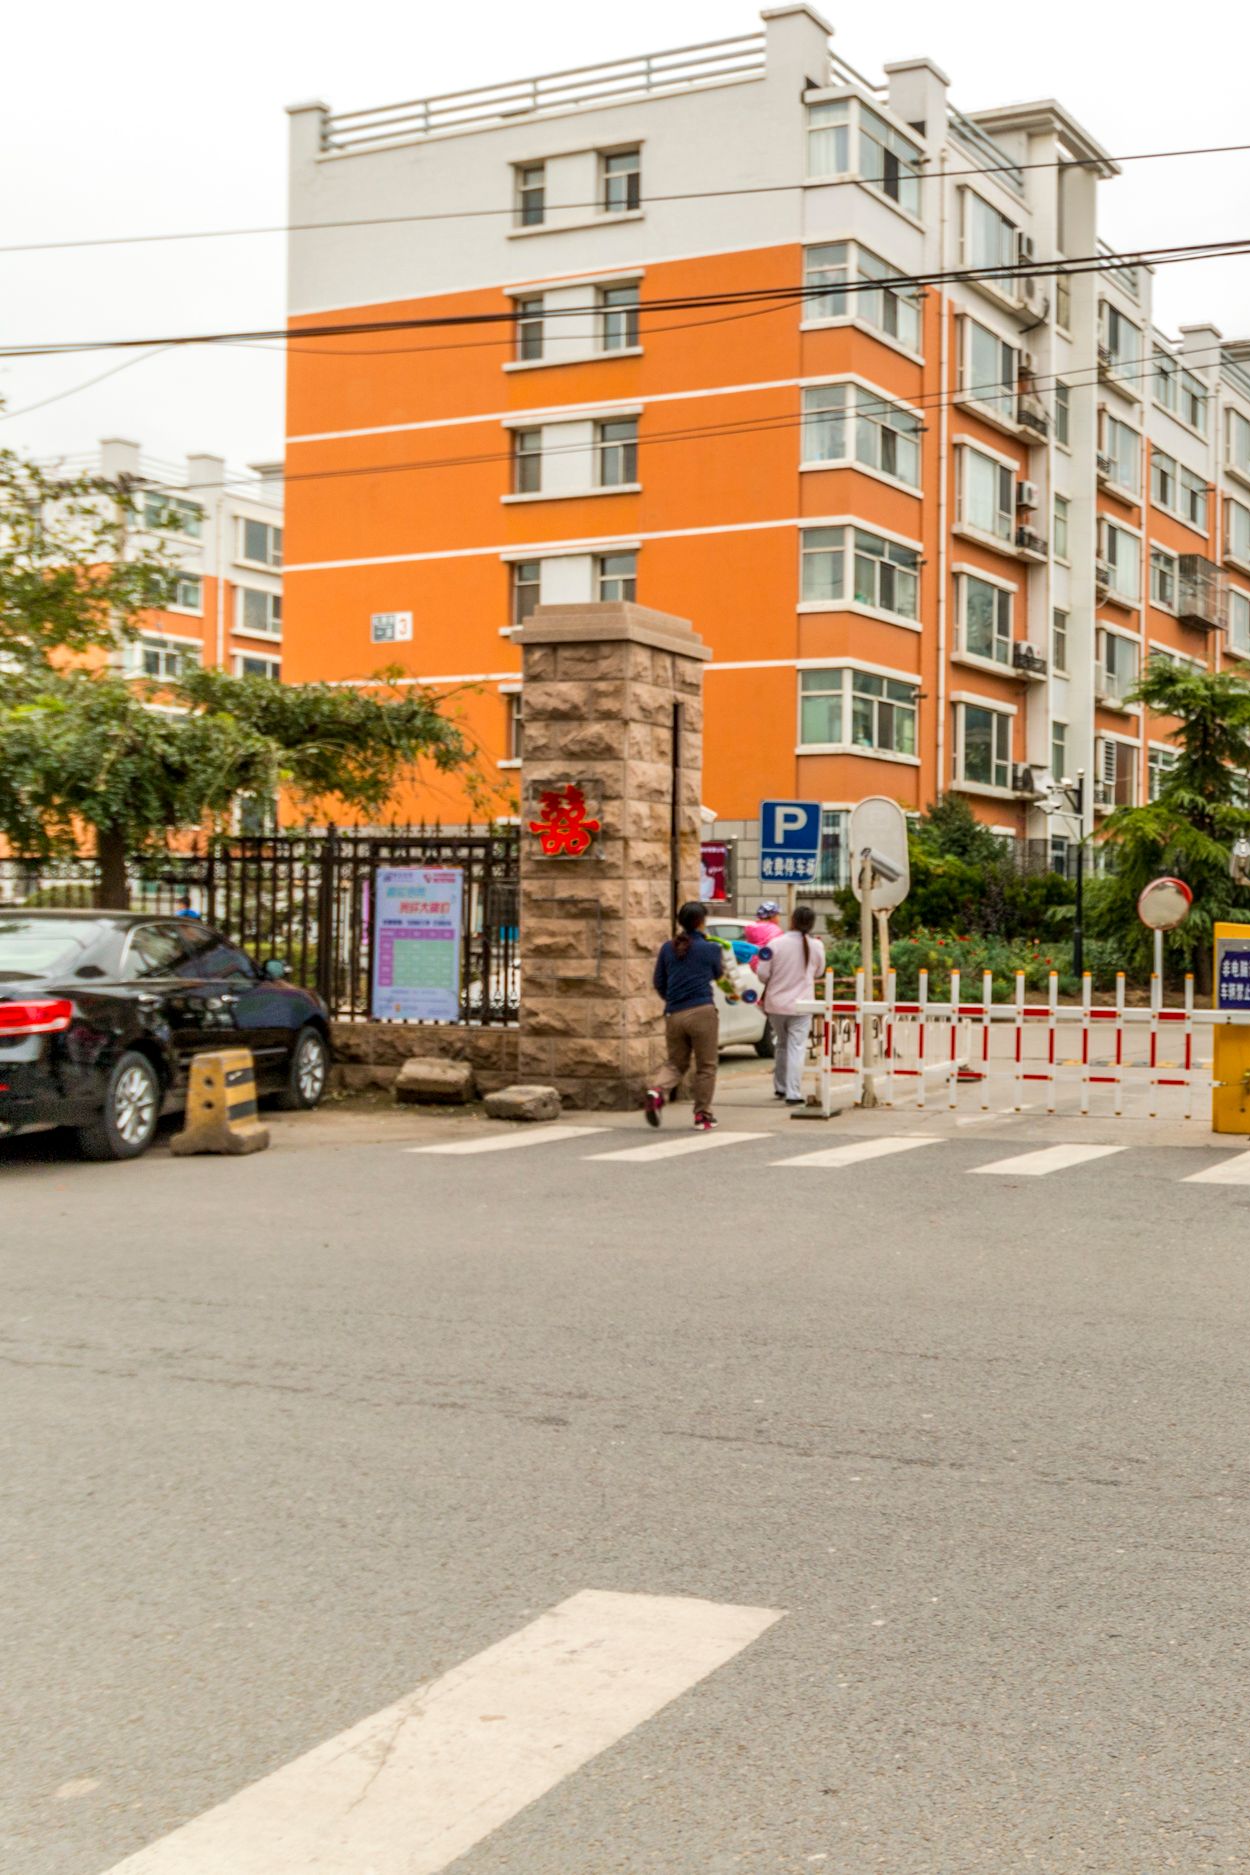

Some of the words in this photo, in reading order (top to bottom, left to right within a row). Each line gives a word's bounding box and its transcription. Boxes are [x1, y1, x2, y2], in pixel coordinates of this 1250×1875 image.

[774, 806, 808, 845] P
[763, 857, 816, 877] 收费停车场
